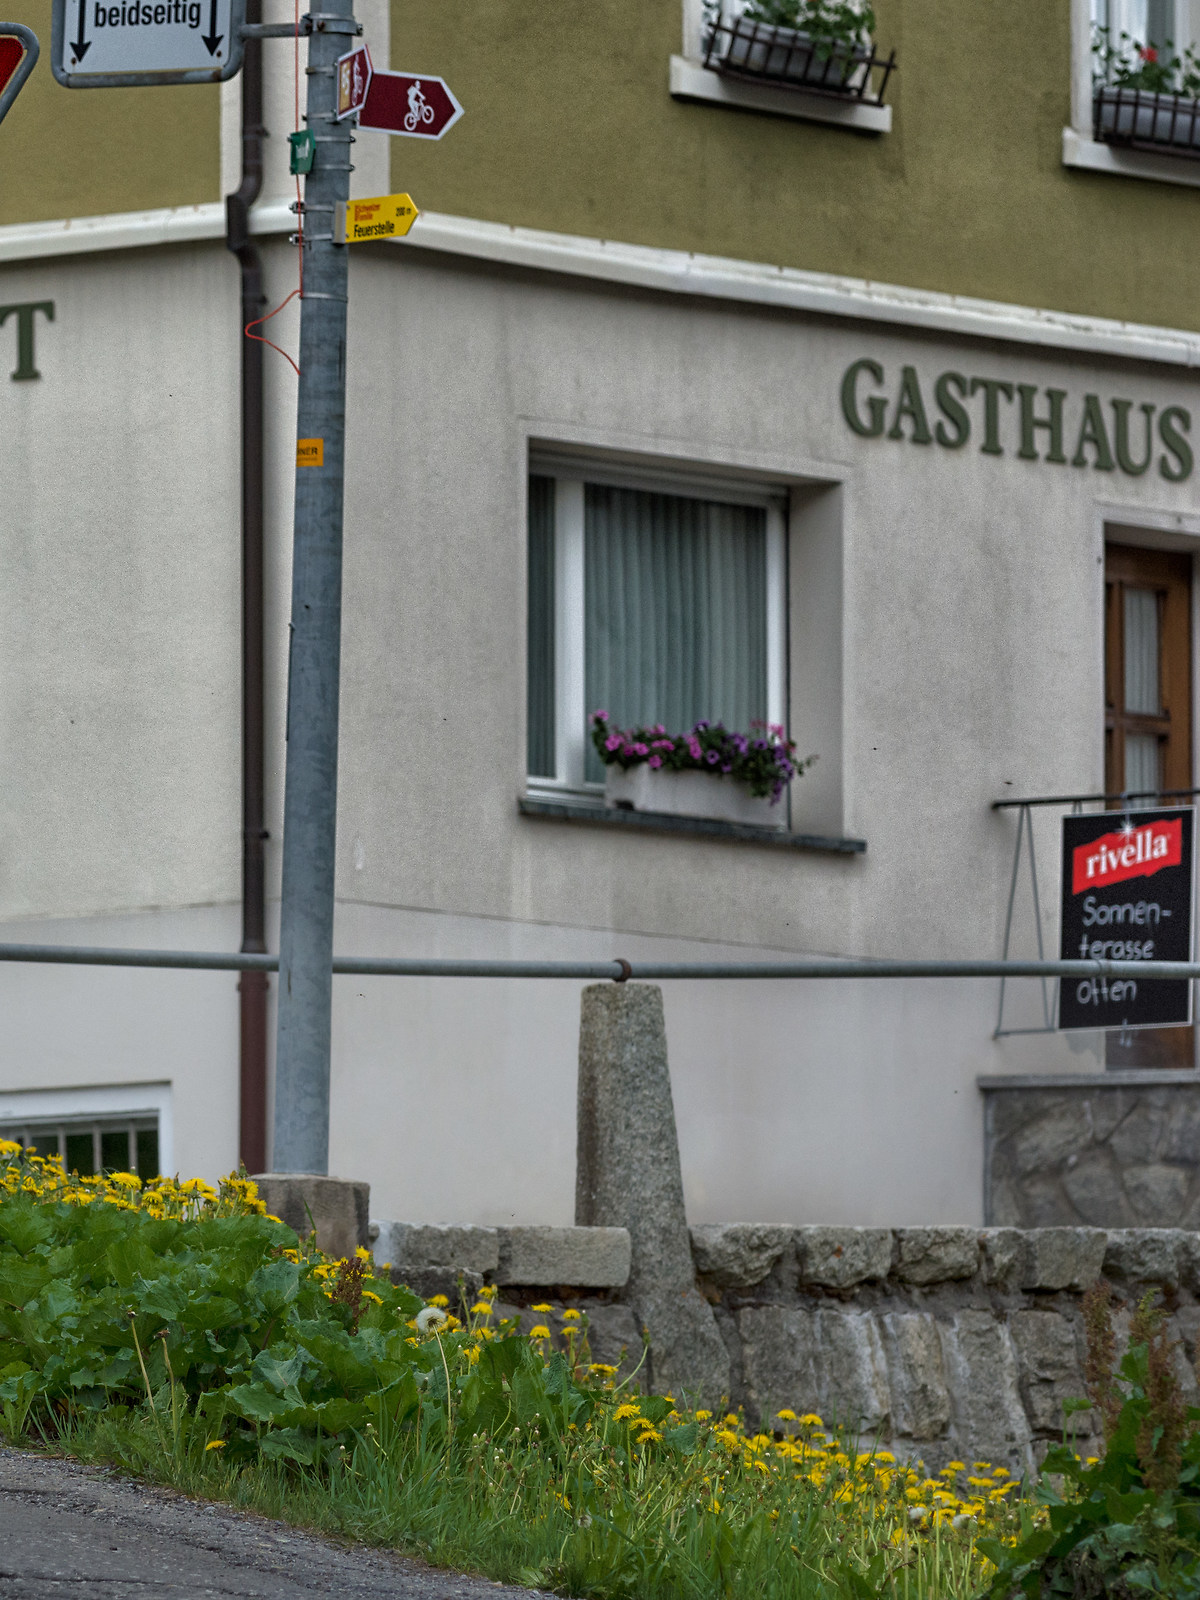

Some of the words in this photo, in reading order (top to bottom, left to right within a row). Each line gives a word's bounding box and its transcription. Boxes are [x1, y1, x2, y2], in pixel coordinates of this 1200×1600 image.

[94, 0, 201, 29] beidseitig
[354, 221, 395, 237] Feuerstelle
[840, 357, 1194, 483] GASTHAUS
[1086, 828, 1168, 878] rivella
[1082, 896, 1172, 926] Sonnen-
[1079, 933, 1156, 960] terasse
